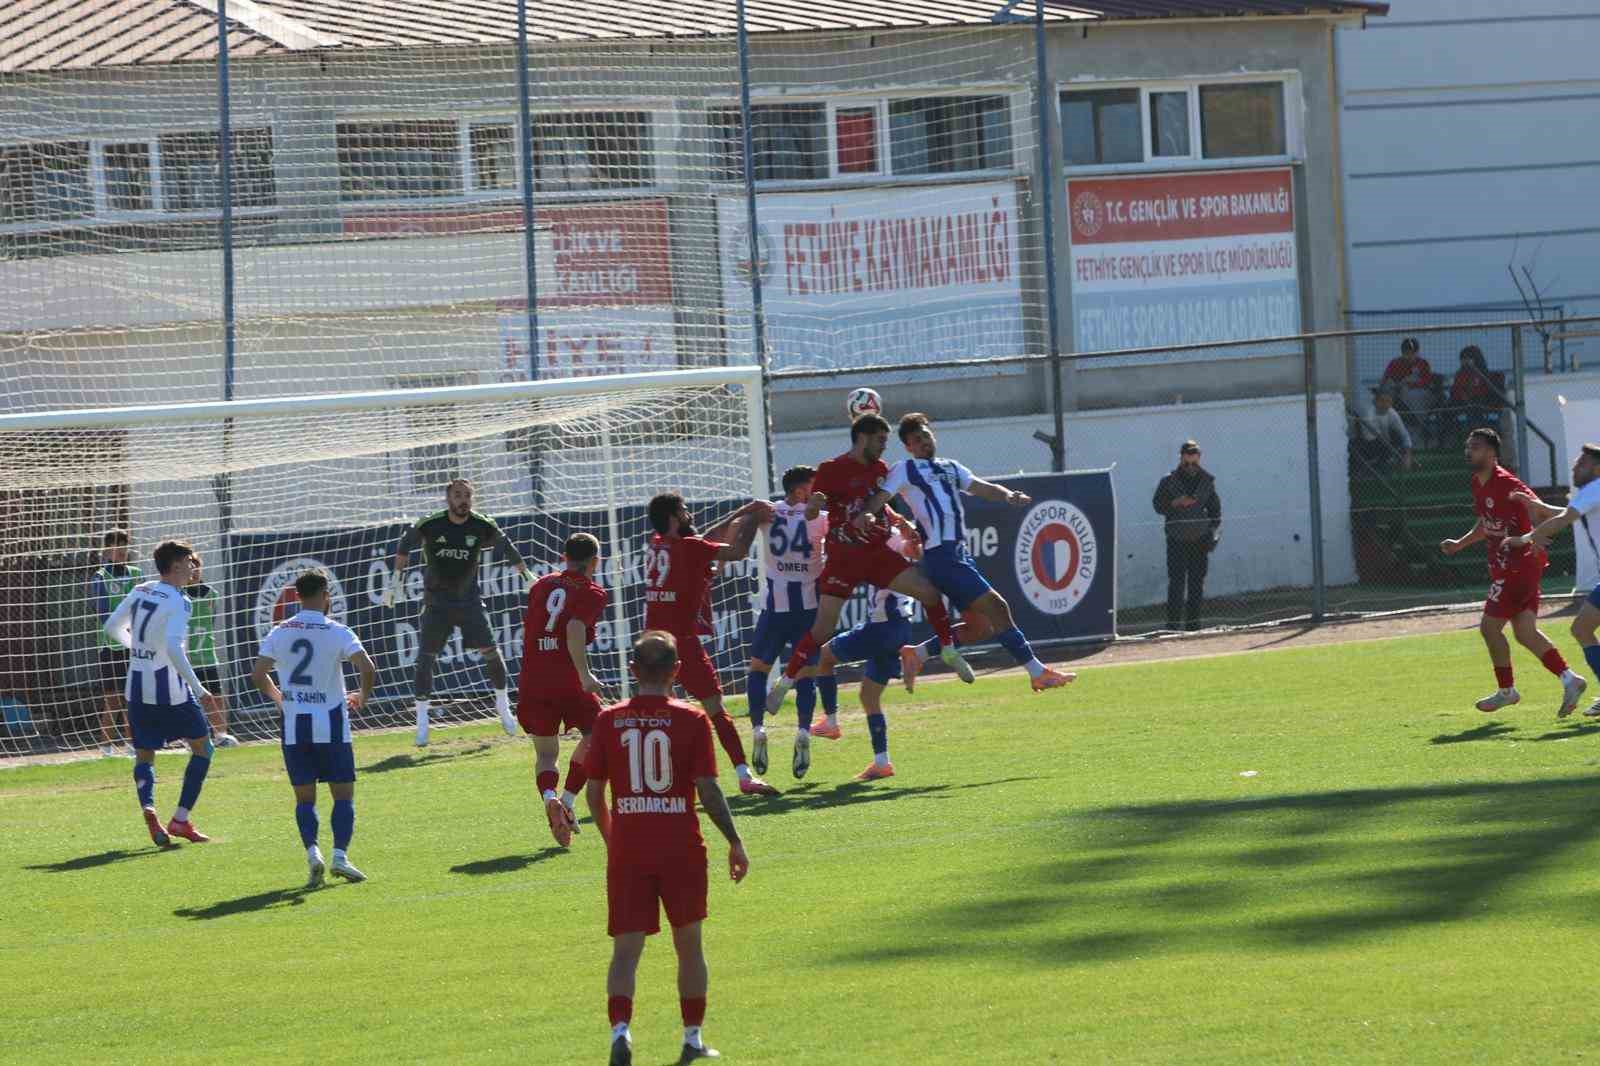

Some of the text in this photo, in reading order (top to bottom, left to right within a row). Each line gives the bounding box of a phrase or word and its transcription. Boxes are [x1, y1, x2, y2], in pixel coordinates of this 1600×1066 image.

[1105, 187, 1289, 228] T.C. GENÇLİK VE SPOR BAKANLIĞI
[783, 196, 1012, 296] FETHİYE KAYMAKAMLIĞI
[1075, 253, 1119, 282] FETHİYE
[1119, 251, 1162, 284] GENÇLİK
[1163, 253, 1177, 278] VE
[1178, 251, 1205, 276] SPOR
[769, 515, 812, 560] 54
[131, 598, 159, 643] 17
[545, 587, 567, 632] 9
[289, 638, 314, 687] 2
[620, 728, 673, 794] 10
[616, 797, 687, 814] SERDARCAN
